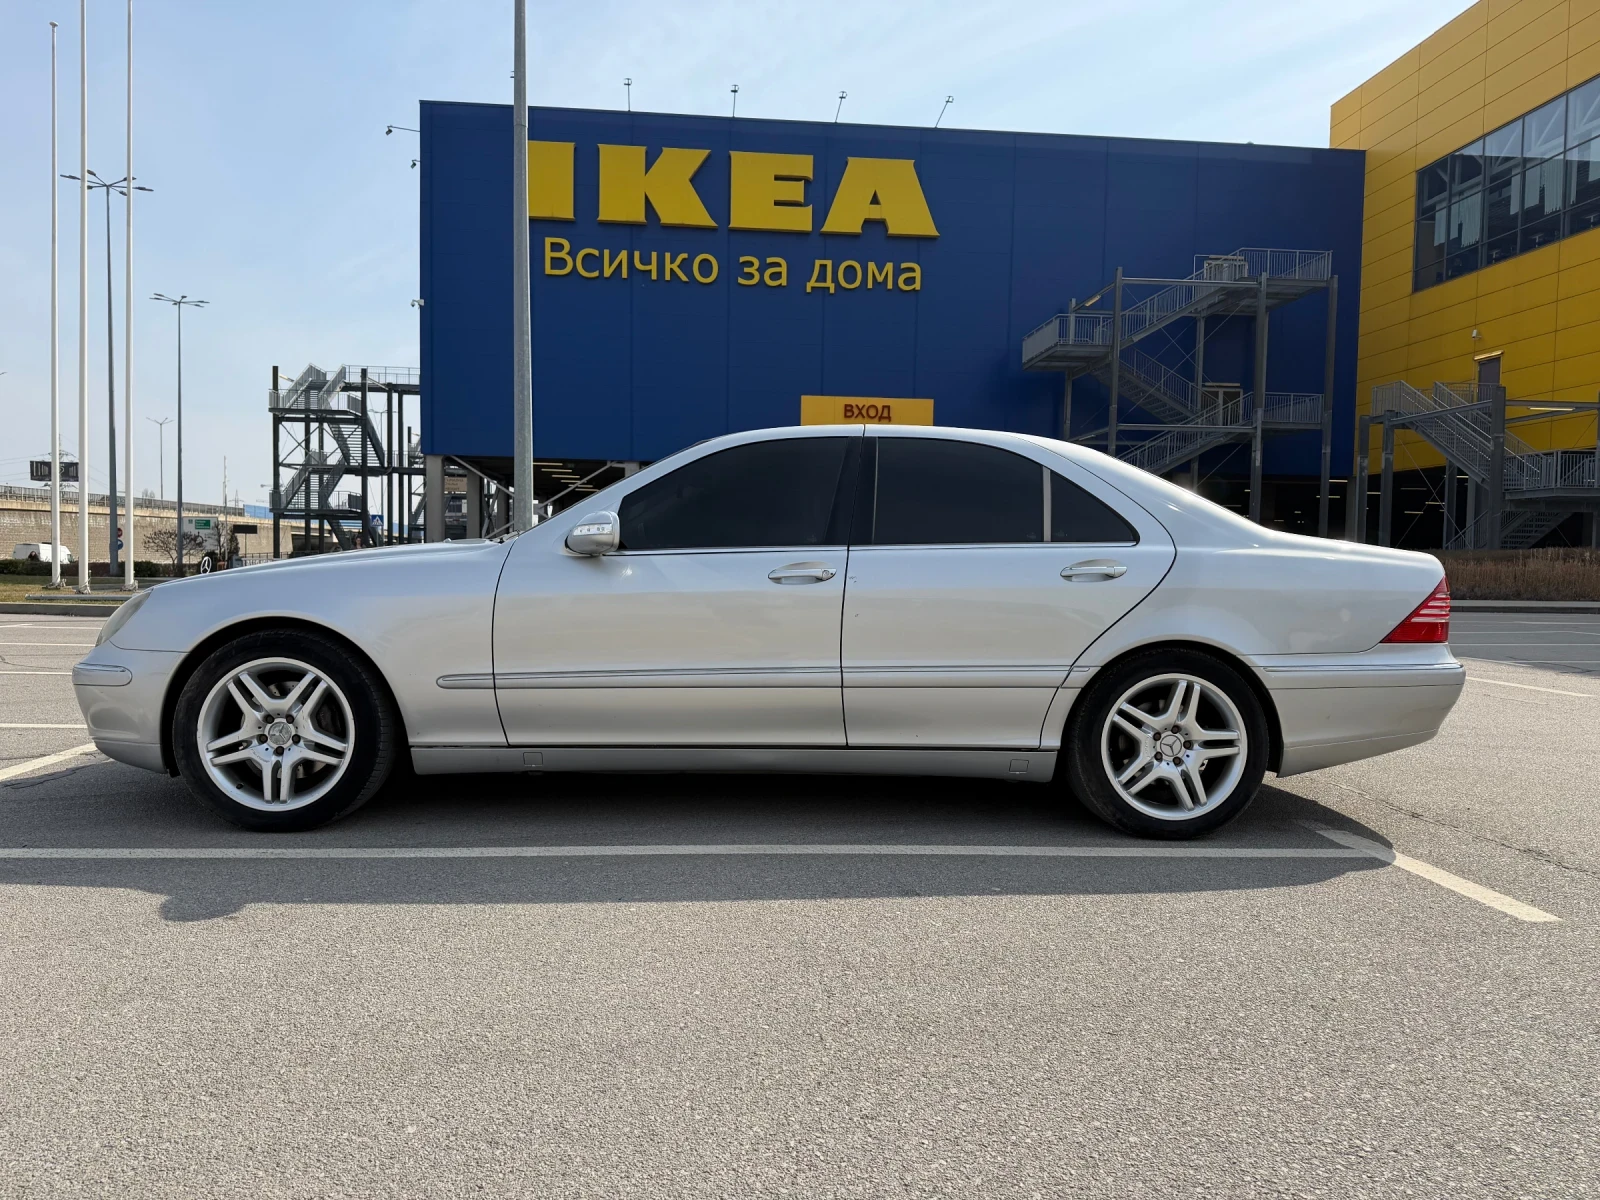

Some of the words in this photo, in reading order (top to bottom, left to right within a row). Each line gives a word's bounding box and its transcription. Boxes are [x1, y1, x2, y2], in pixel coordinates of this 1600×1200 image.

[527, 140, 940, 239] IKEA
[543, 236, 719, 284] Всичко
[737, 255, 788, 287] за
[805, 259, 922, 294] дома
[843, 403, 892, 422] ВХОД
